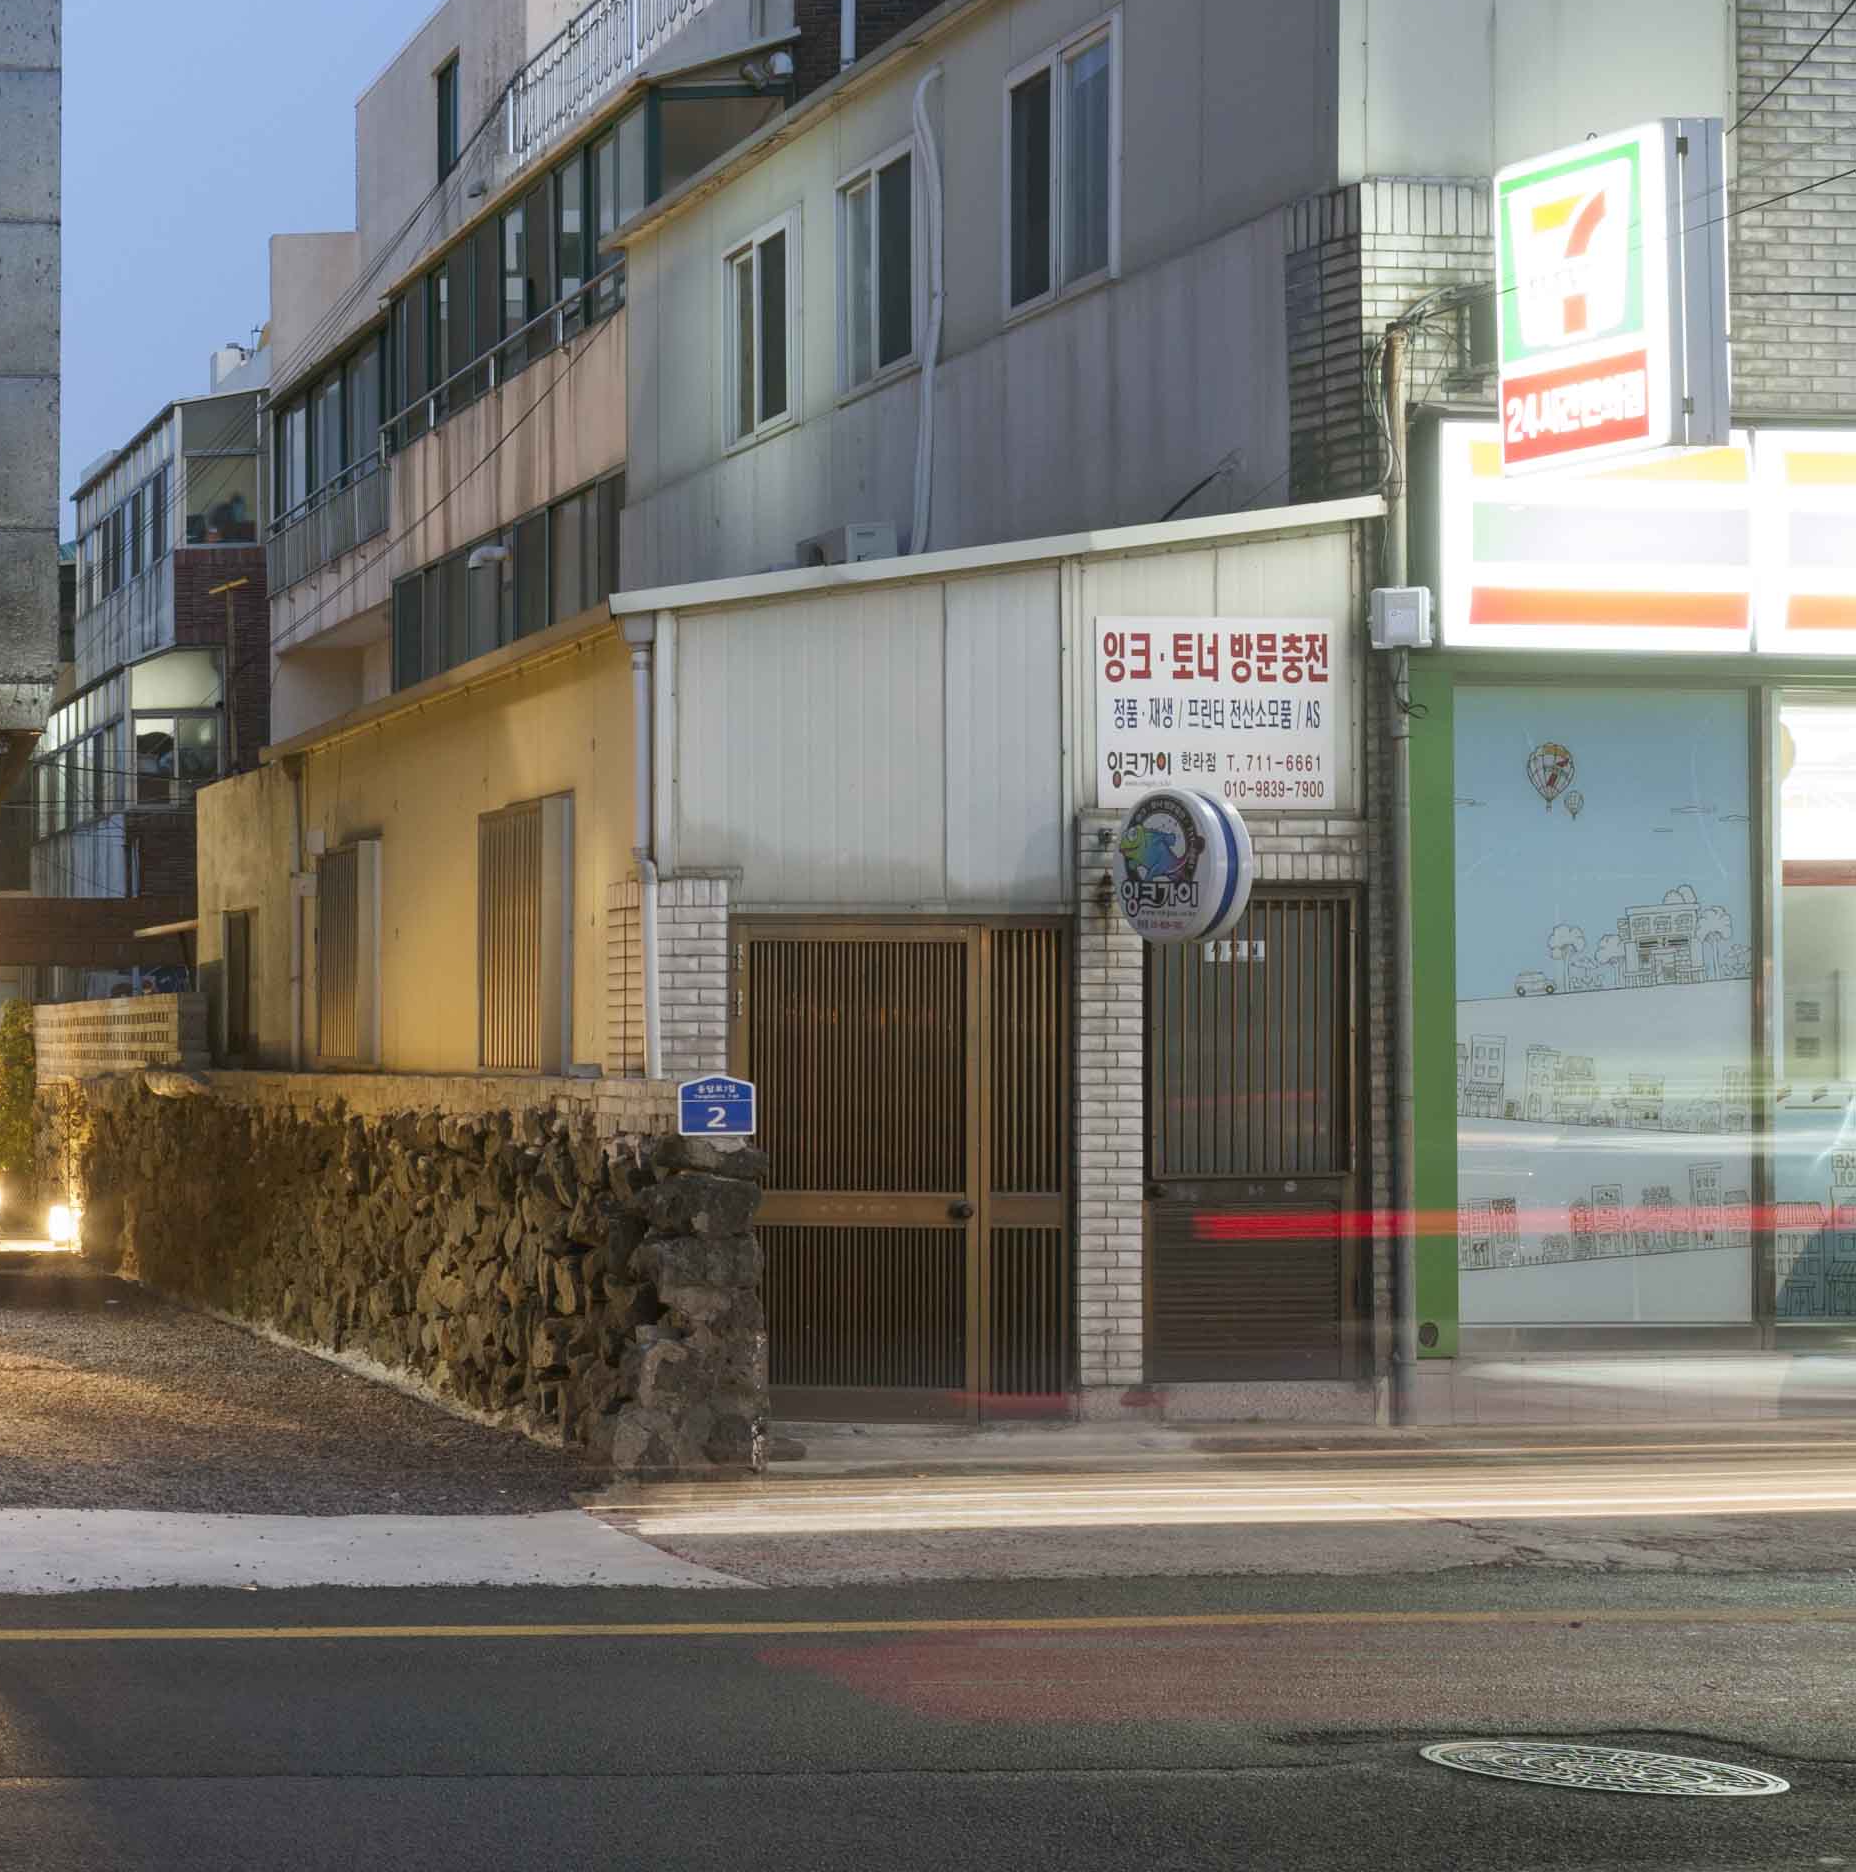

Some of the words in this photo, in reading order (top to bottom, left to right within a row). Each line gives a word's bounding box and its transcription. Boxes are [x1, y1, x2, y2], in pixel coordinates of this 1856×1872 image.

[1230, 632, 1329, 684] 방문충전
[1187, 698, 1225, 729] 프린터
[1229, 698, 1293, 730] 전산소모품
[1305, 699, 1321, 729] AS
[1107, 751, 1171, 789] 잉크가이
[1181, 751, 1217, 773] 한라점
[1246, 753, 1321, 772] 711-6661
[1224, 779, 1325, 798] 010-9839-7900
[1120, 879, 1200, 918] 잉크가이
[707, 1106, 728, 1128] 2
